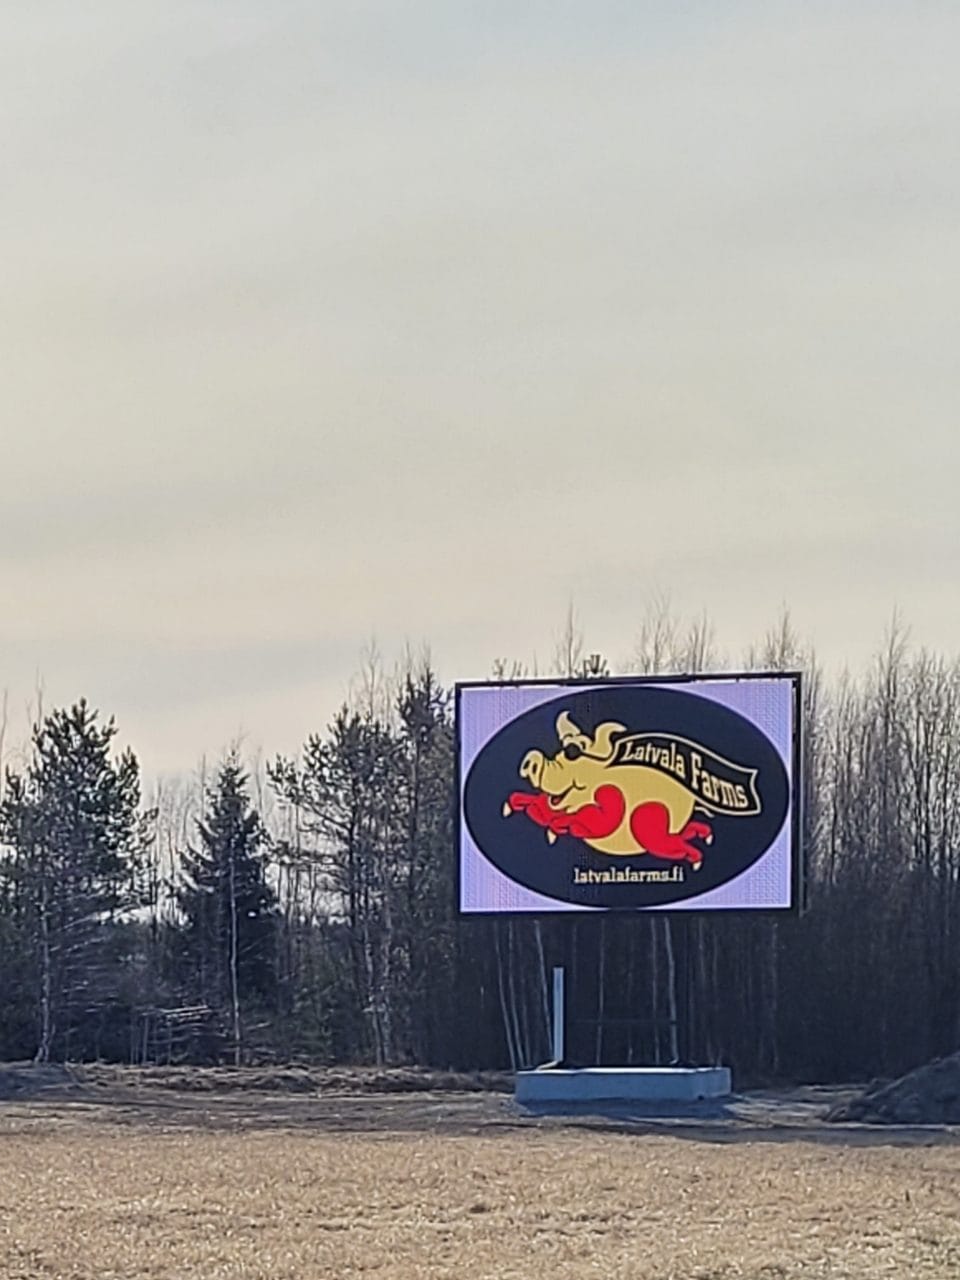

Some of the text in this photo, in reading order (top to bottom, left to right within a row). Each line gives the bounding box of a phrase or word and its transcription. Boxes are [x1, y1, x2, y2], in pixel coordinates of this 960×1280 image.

[620, 741, 749, 808] Latvala Farms
[574, 866, 684, 884] latvalafarms.fi
